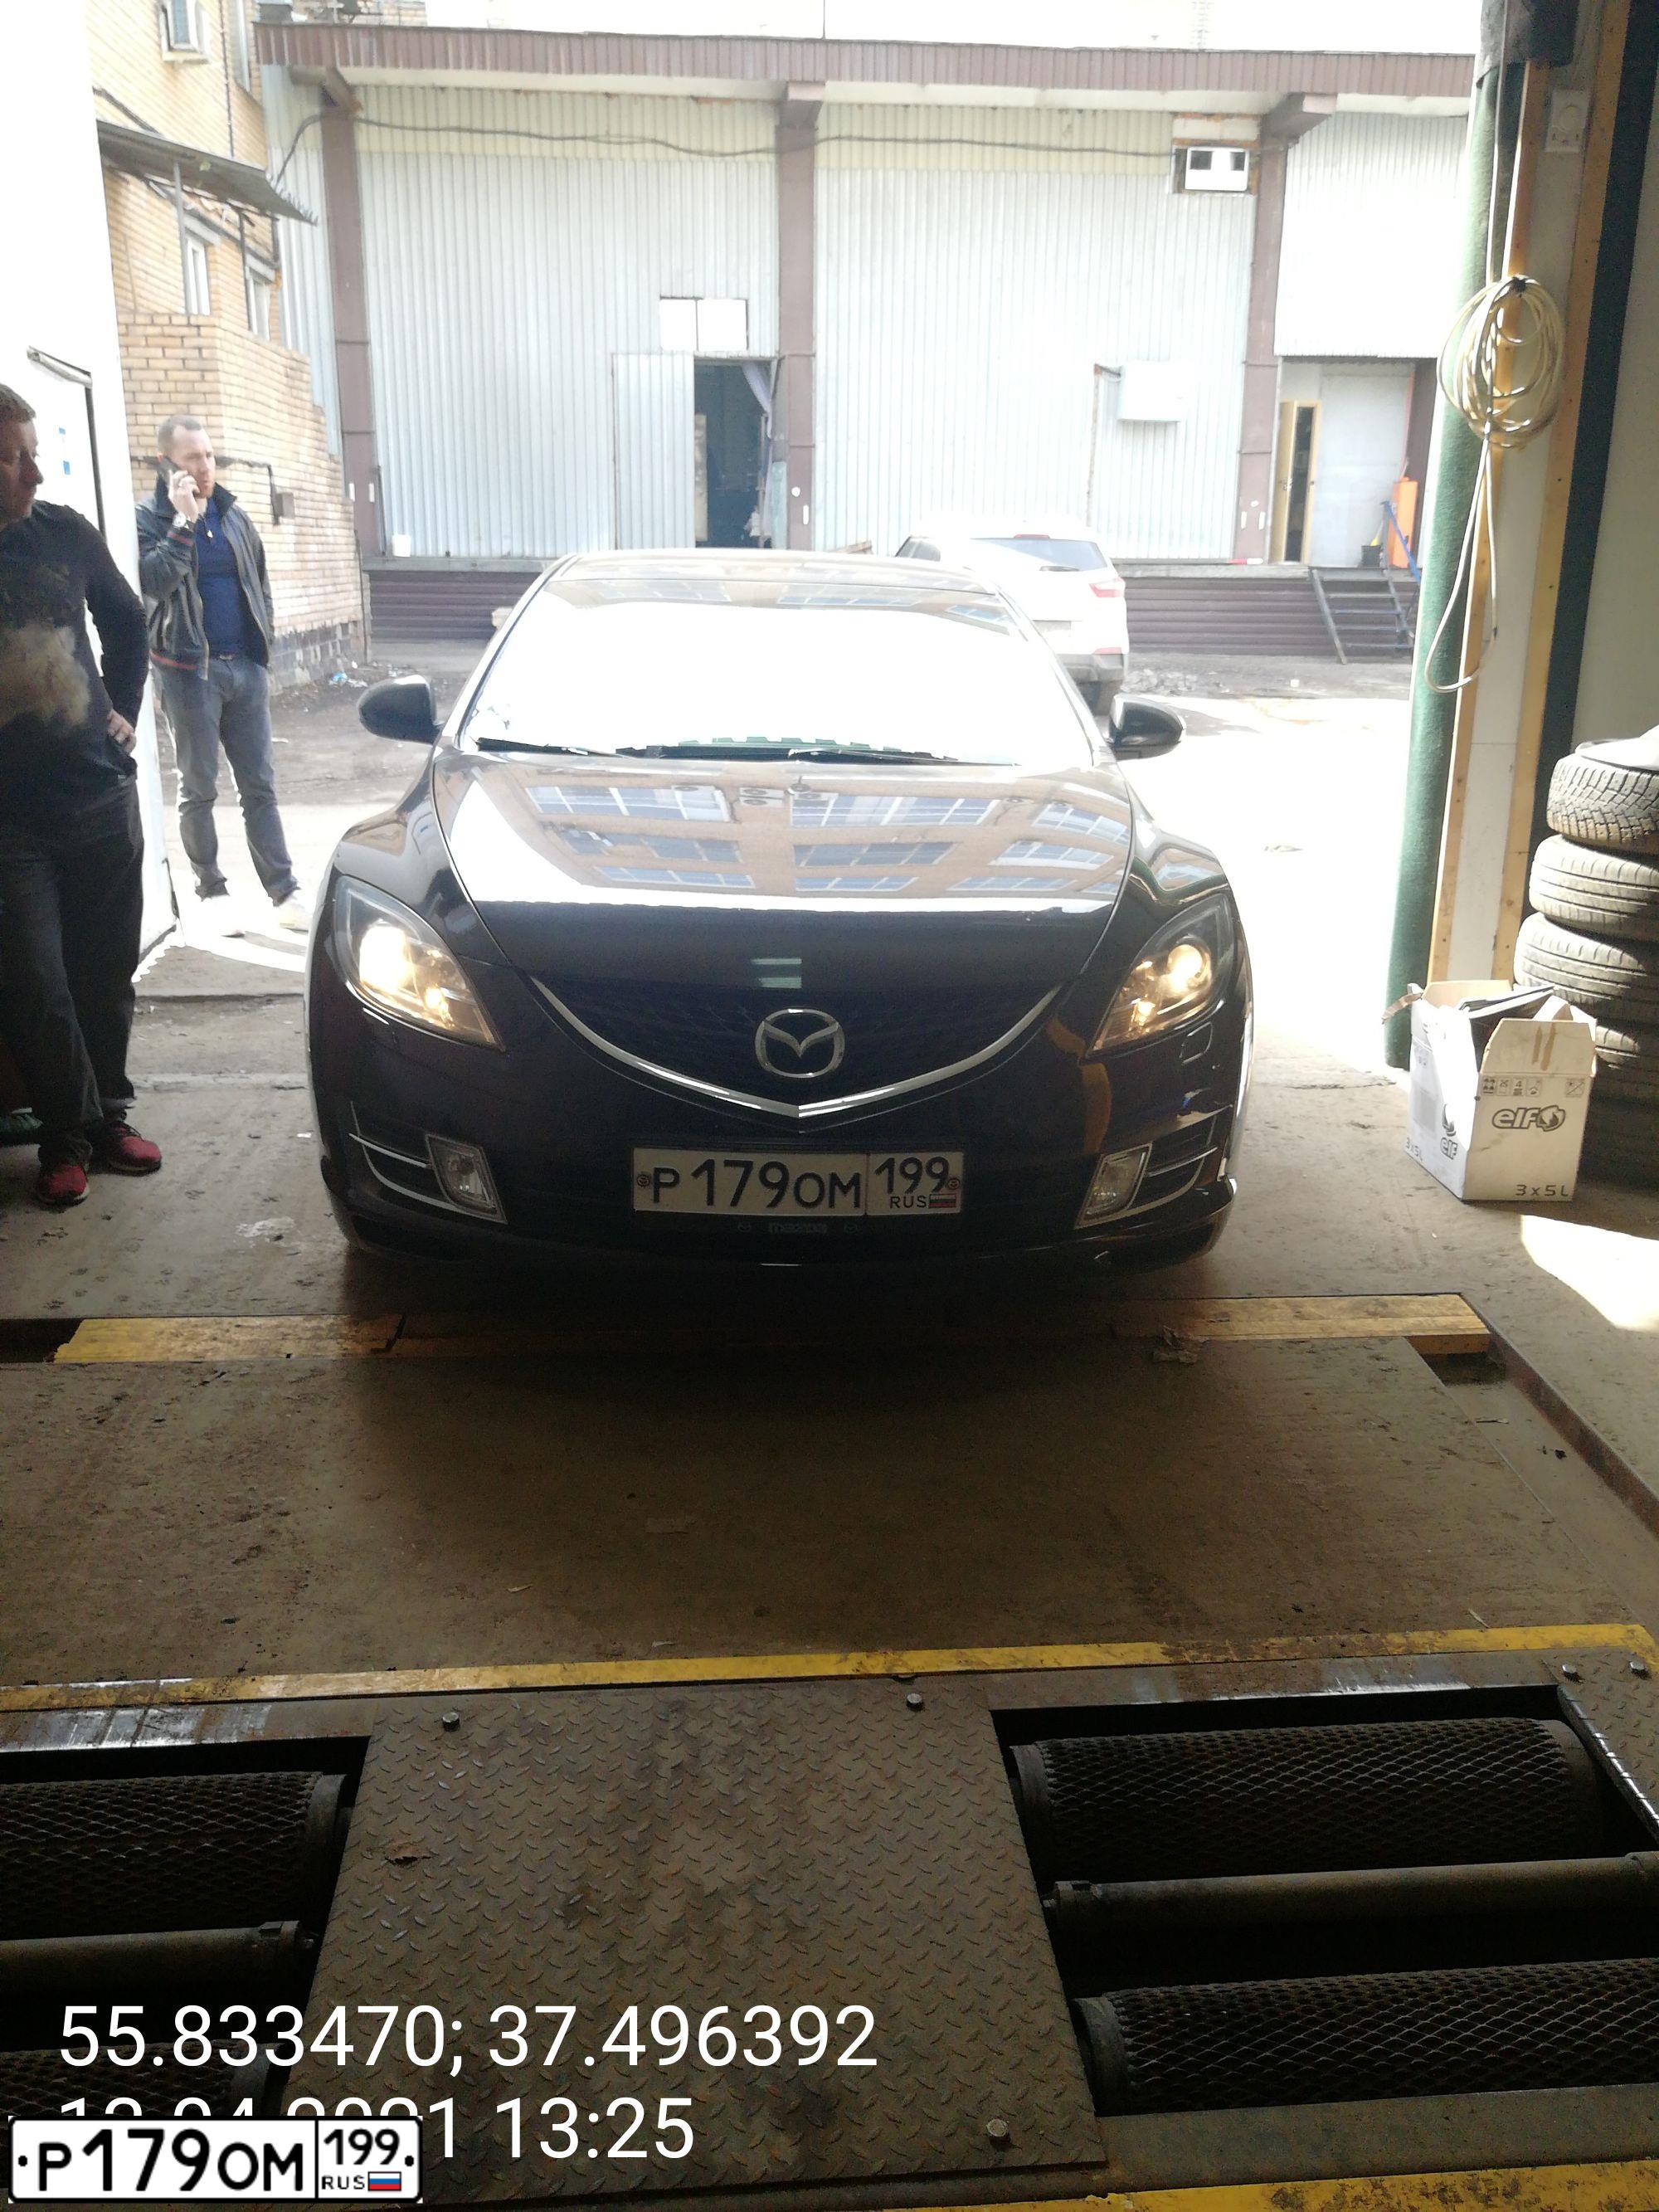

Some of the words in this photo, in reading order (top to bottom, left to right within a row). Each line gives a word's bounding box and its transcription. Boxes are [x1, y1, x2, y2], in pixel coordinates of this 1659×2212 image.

[1492, 1108, 1540, 1129] elf
[874, 1157, 949, 1194] 199
[890, 1196, 927, 1209] RUS
